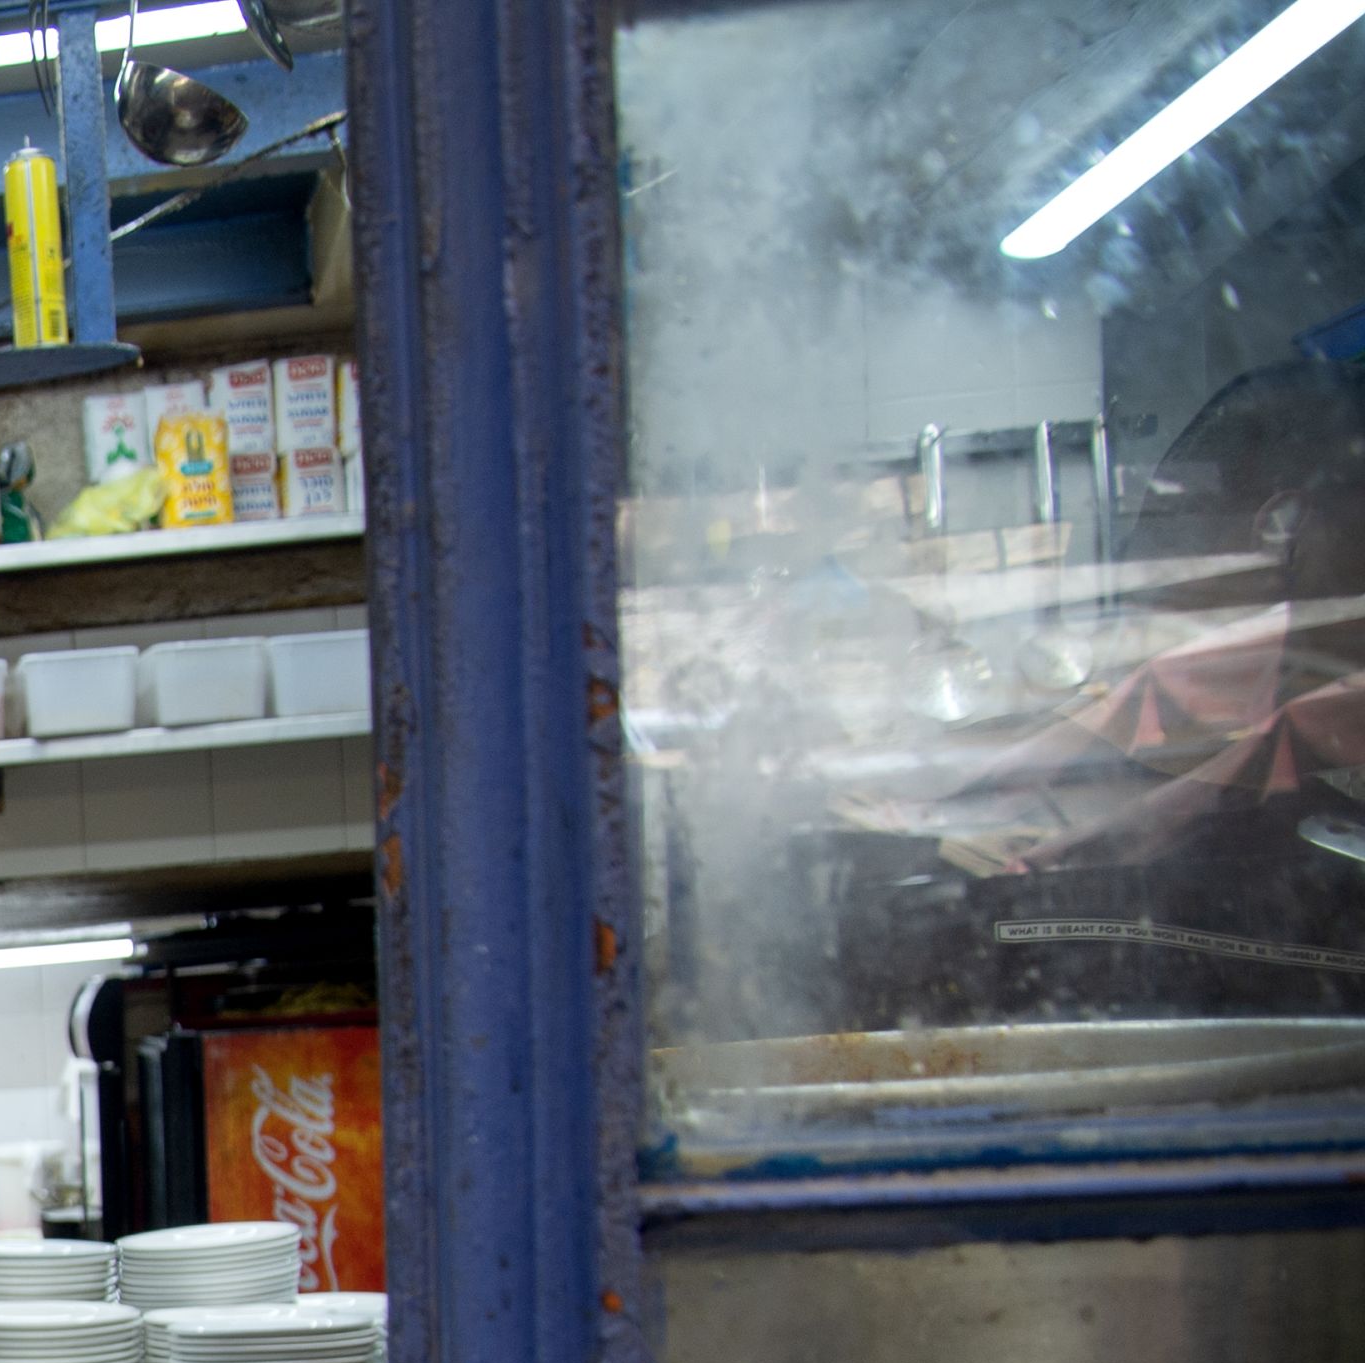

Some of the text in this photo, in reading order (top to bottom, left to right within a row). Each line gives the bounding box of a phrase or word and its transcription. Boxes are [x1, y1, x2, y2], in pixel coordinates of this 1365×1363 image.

[1008, 924, 1038, 937] WHAT
[1043, 925, 1052, 935] IS
[1056, 924, 1094, 935] MEANT
[1099, 924, 1122, 934] FOR
[1125, 926, 1148, 937] YOU
[1271, 947, 1322, 961] YOURSELF
[1325, 953, 1348, 965] AND
